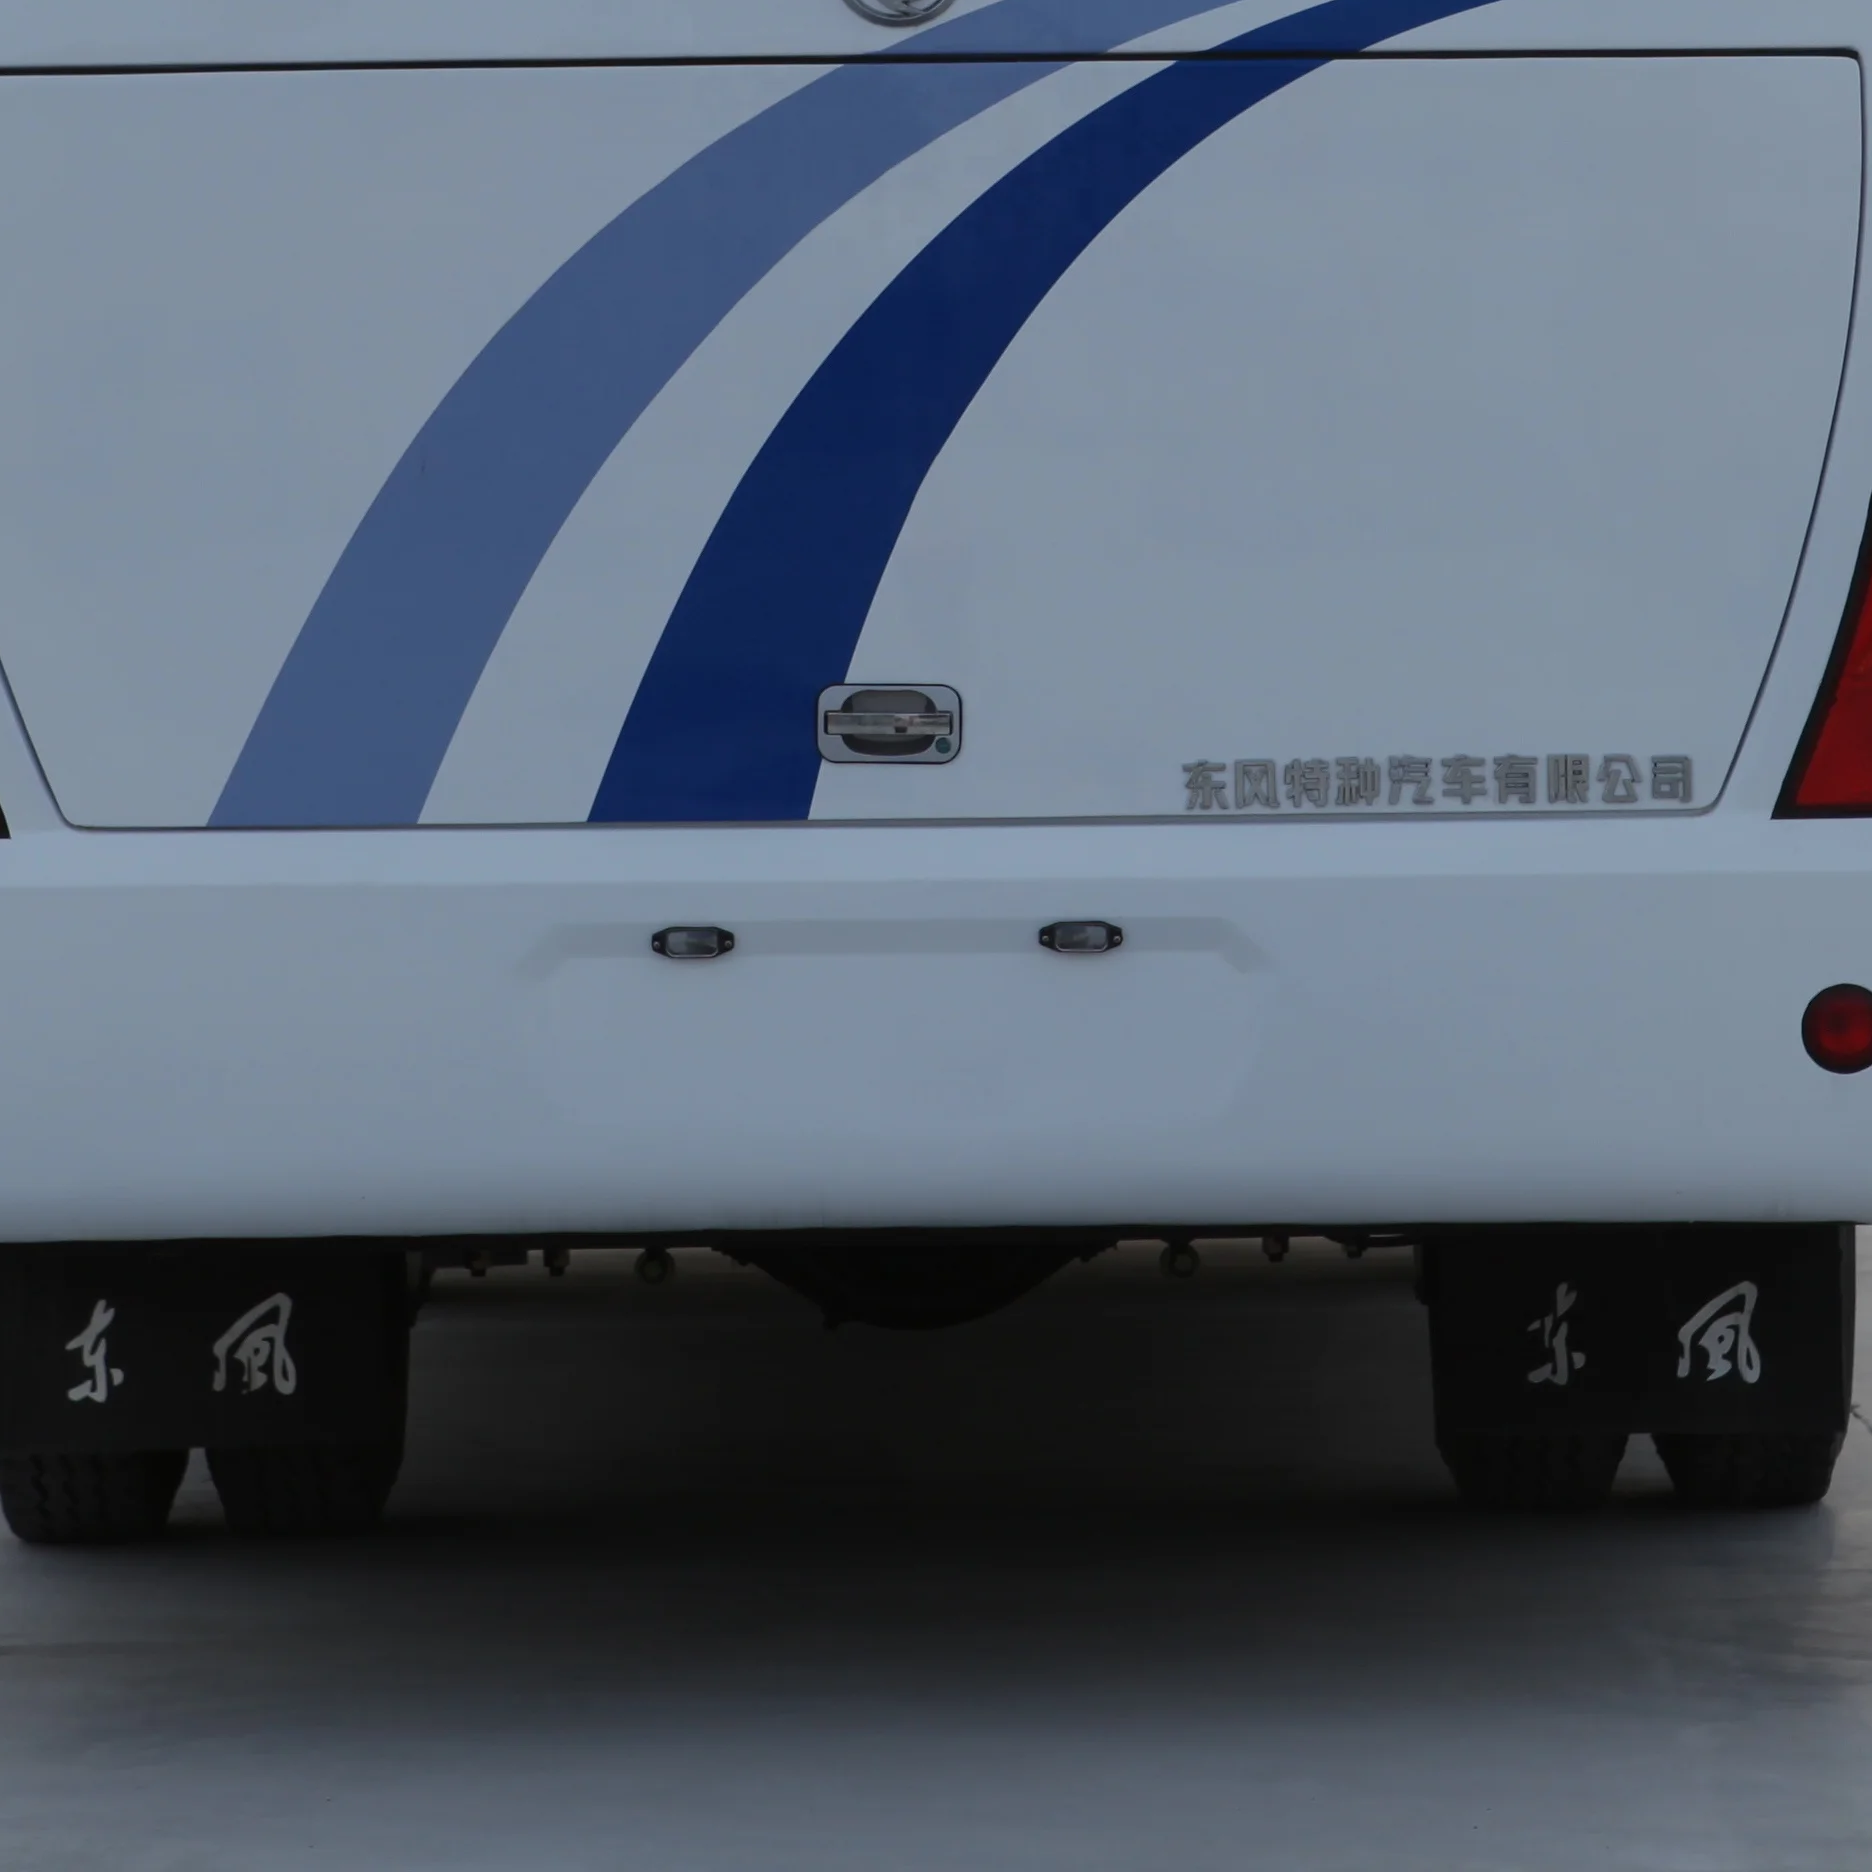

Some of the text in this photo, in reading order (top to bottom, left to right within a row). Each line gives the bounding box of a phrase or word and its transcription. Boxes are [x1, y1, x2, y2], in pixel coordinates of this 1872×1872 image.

[1182, 754, 1693, 810] 东风特种汽车有限公司
